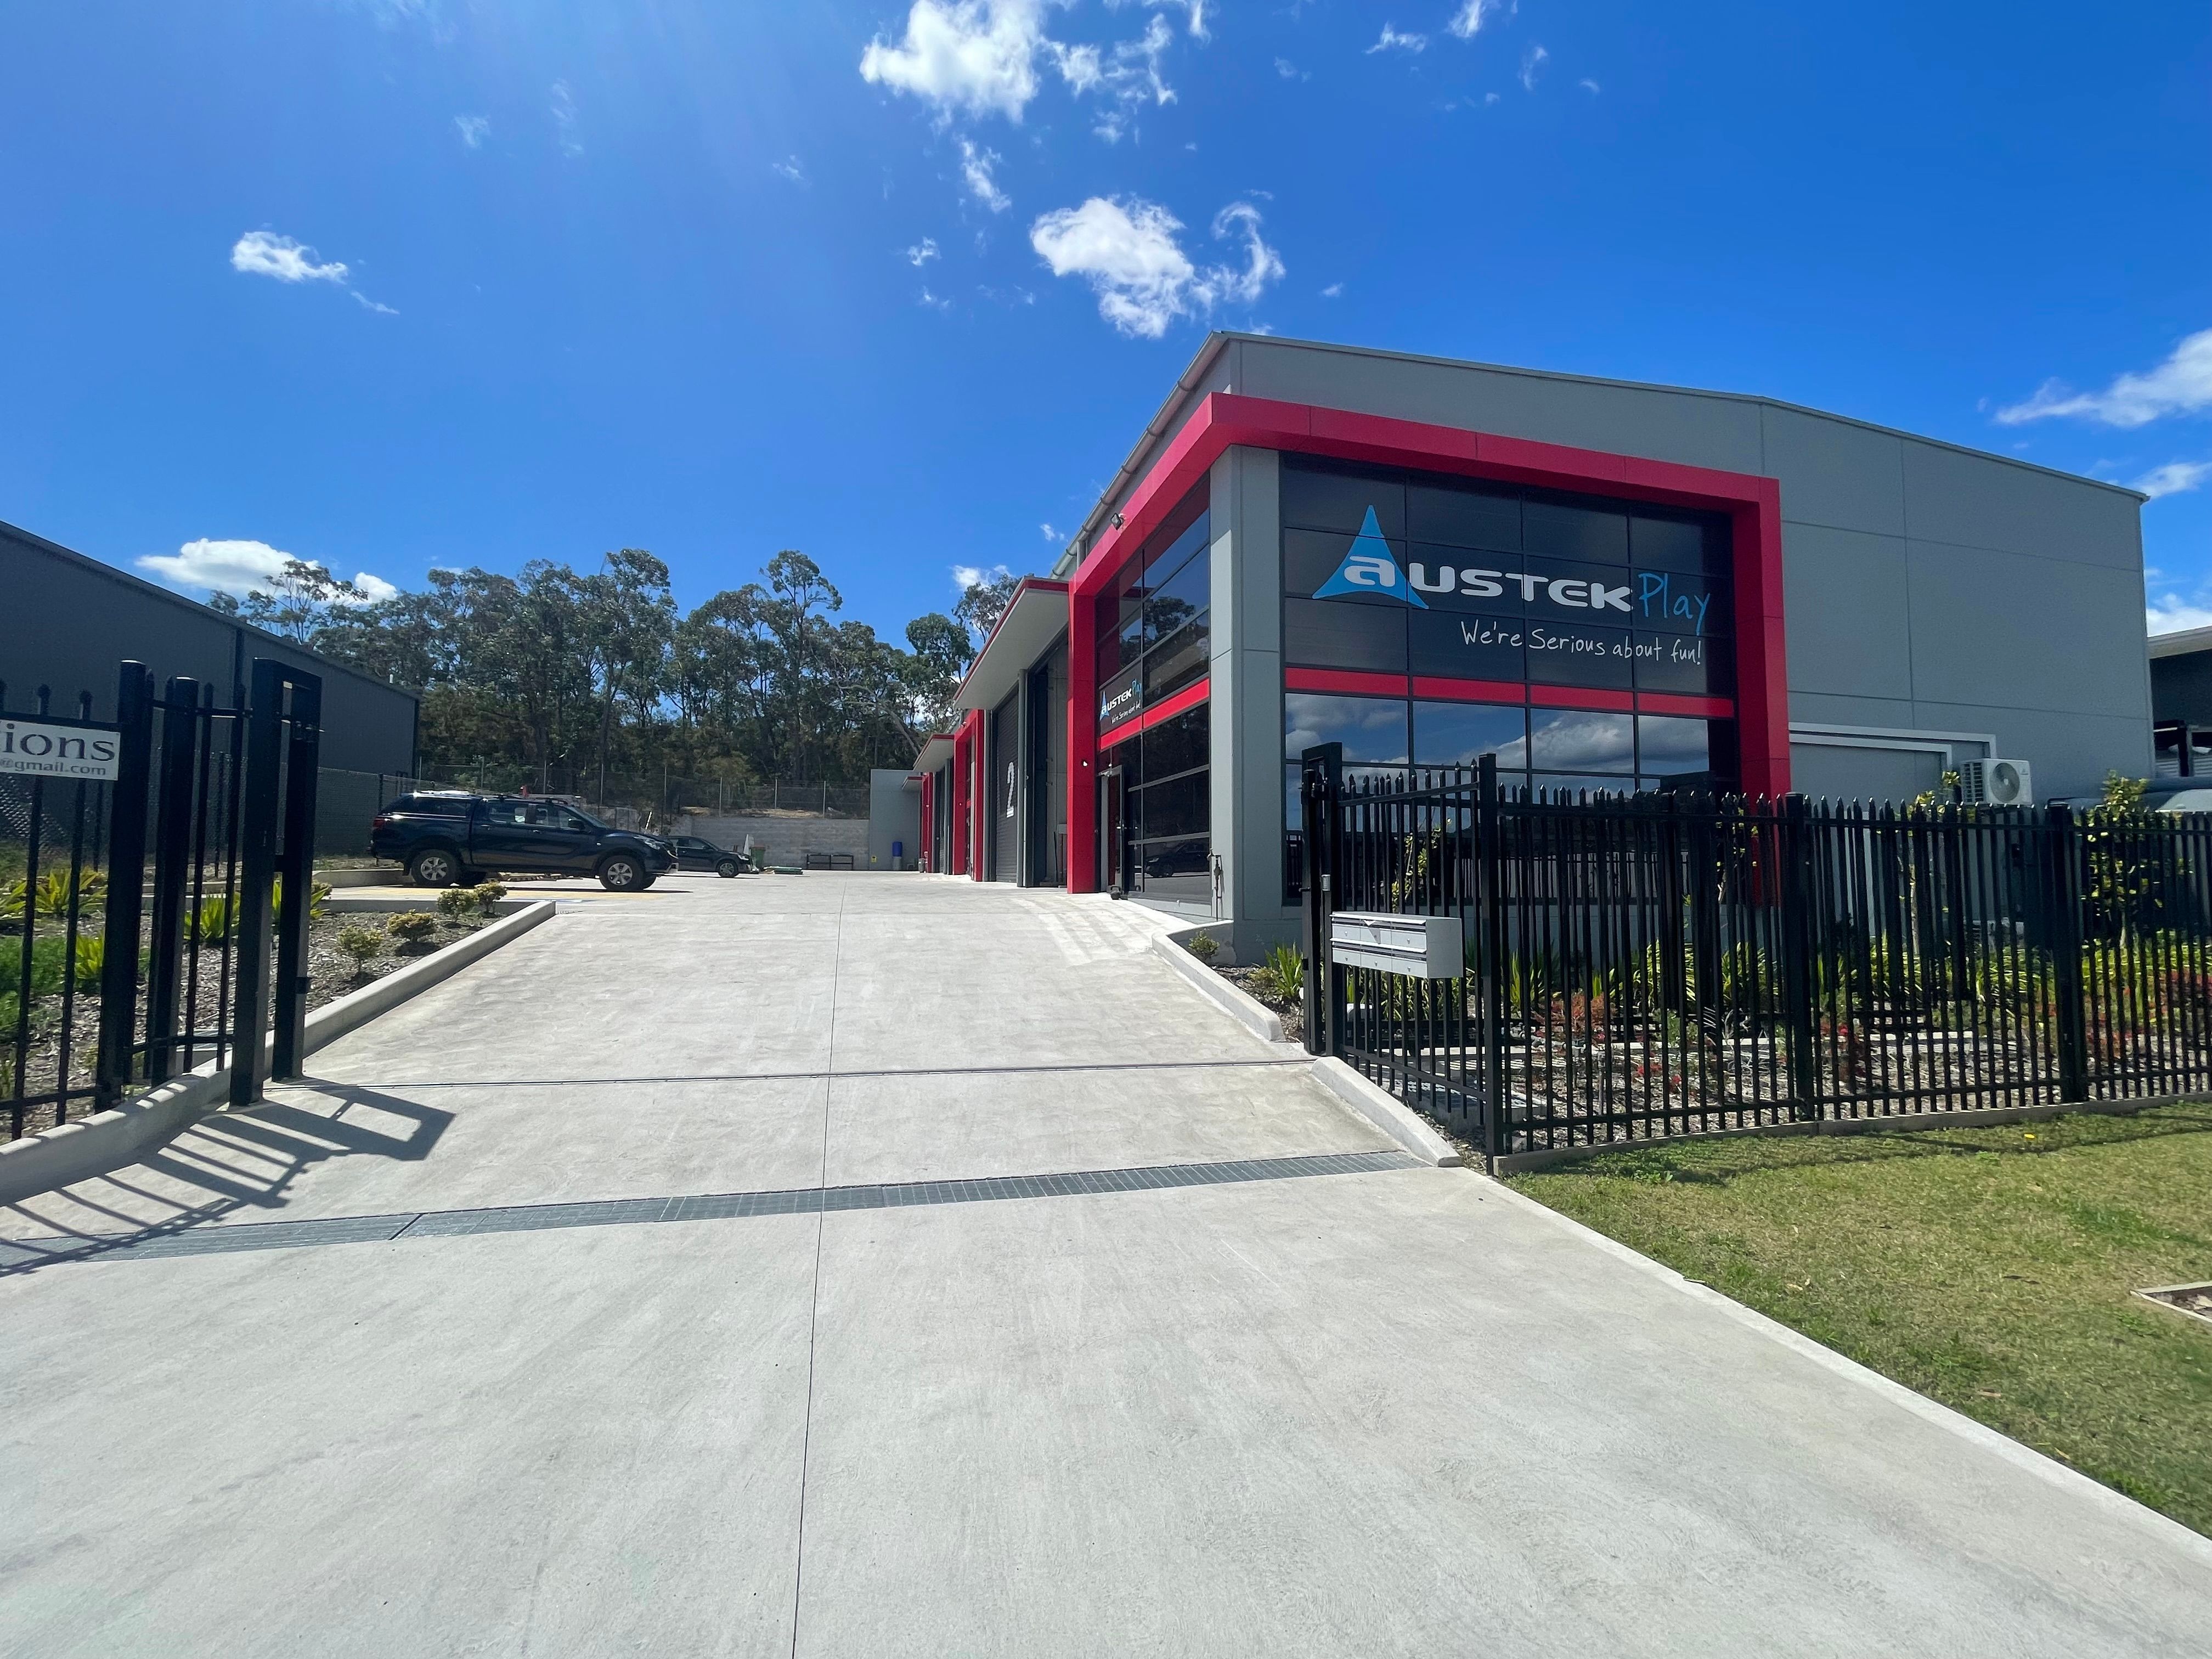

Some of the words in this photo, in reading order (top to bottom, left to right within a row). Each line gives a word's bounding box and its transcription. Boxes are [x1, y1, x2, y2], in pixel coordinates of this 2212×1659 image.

[1638, 572, 1711, 636] Play
[1461, 619, 1522, 647] We're
[1528, 628, 1606, 656] Serious
[1612, 635, 1663, 661] about
[1670, 638, 1702, 665] fun!
[2, 723, 115, 761] ions
[0, 758, 106, 776] @gmail.com
[1006, 761, 1015, 818] 2
